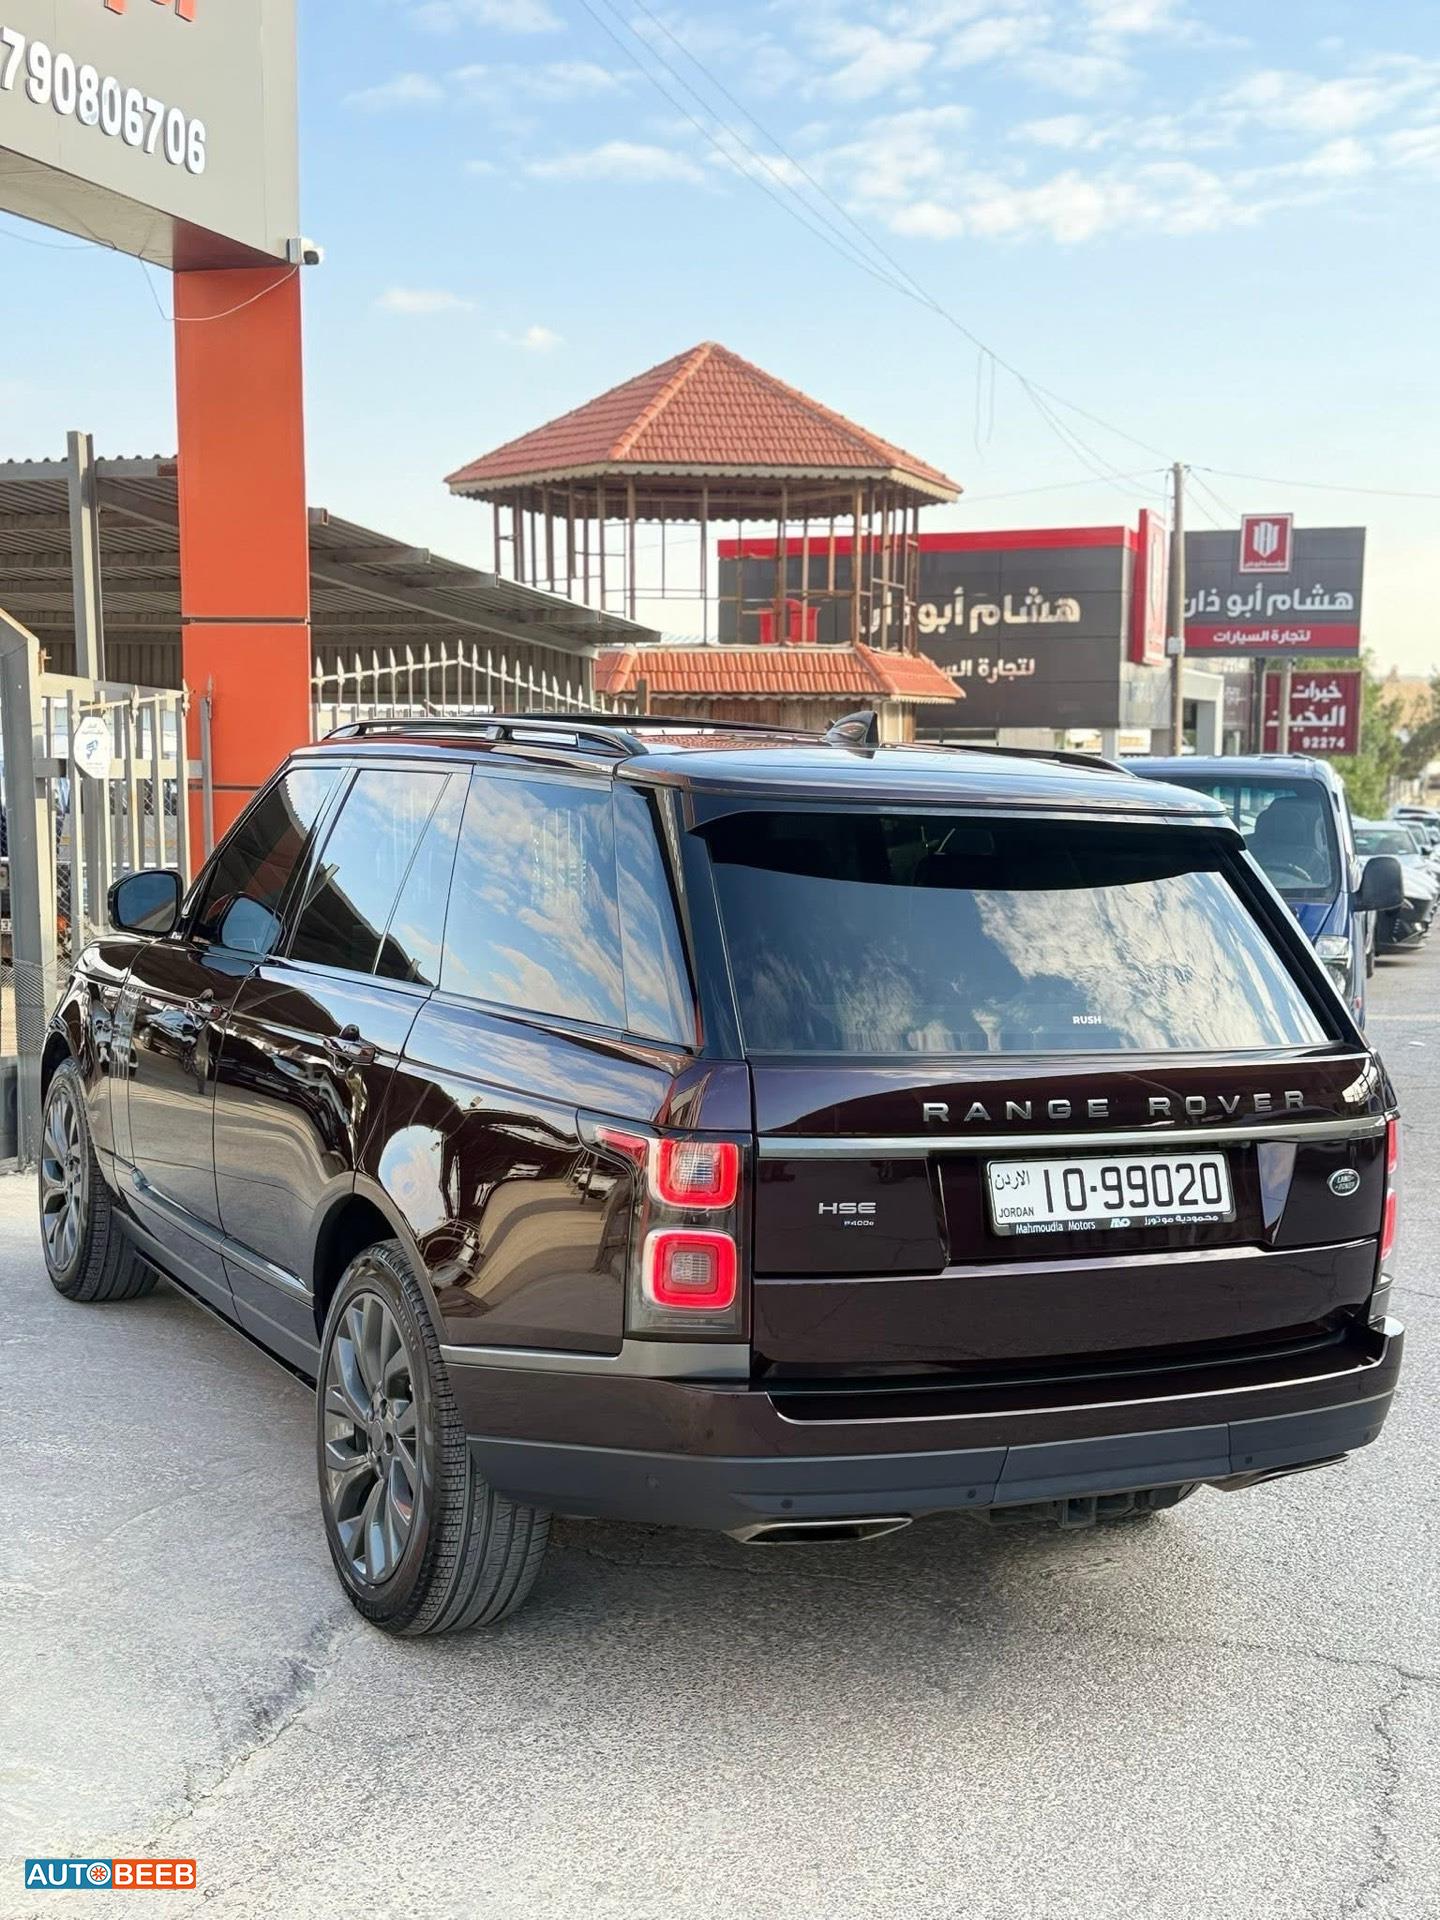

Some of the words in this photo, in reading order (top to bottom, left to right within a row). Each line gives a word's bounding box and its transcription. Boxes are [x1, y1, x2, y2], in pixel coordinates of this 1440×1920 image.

[0, 26, 206, 175] 790806706
[918, 586, 964, 633] أبو
[970, 587, 1081, 634] هشام
[1226, 582, 1263, 618] أبو
[1266, 584, 1354, 616] هشام
[1213, 630, 1270, 645] السيارات
[1271, 630, 1311, 645] لتجارة
[978, 658, 1035, 683] لتجارة
[1291, 680, 1342, 703] خيرات
[1072, 1015, 1102, 1025] RUSH
[922, 1099, 1110, 1123] RANGE
[1148, 1090, 1305, 1117] ROVER
[818, 1202, 877, 1215] HSE
[998, 1206, 1035, 1219] JORDAN
[1015, 1219, 1064, 1235] Mahmoudia
[1068, 1219, 1096, 1232] Motors
